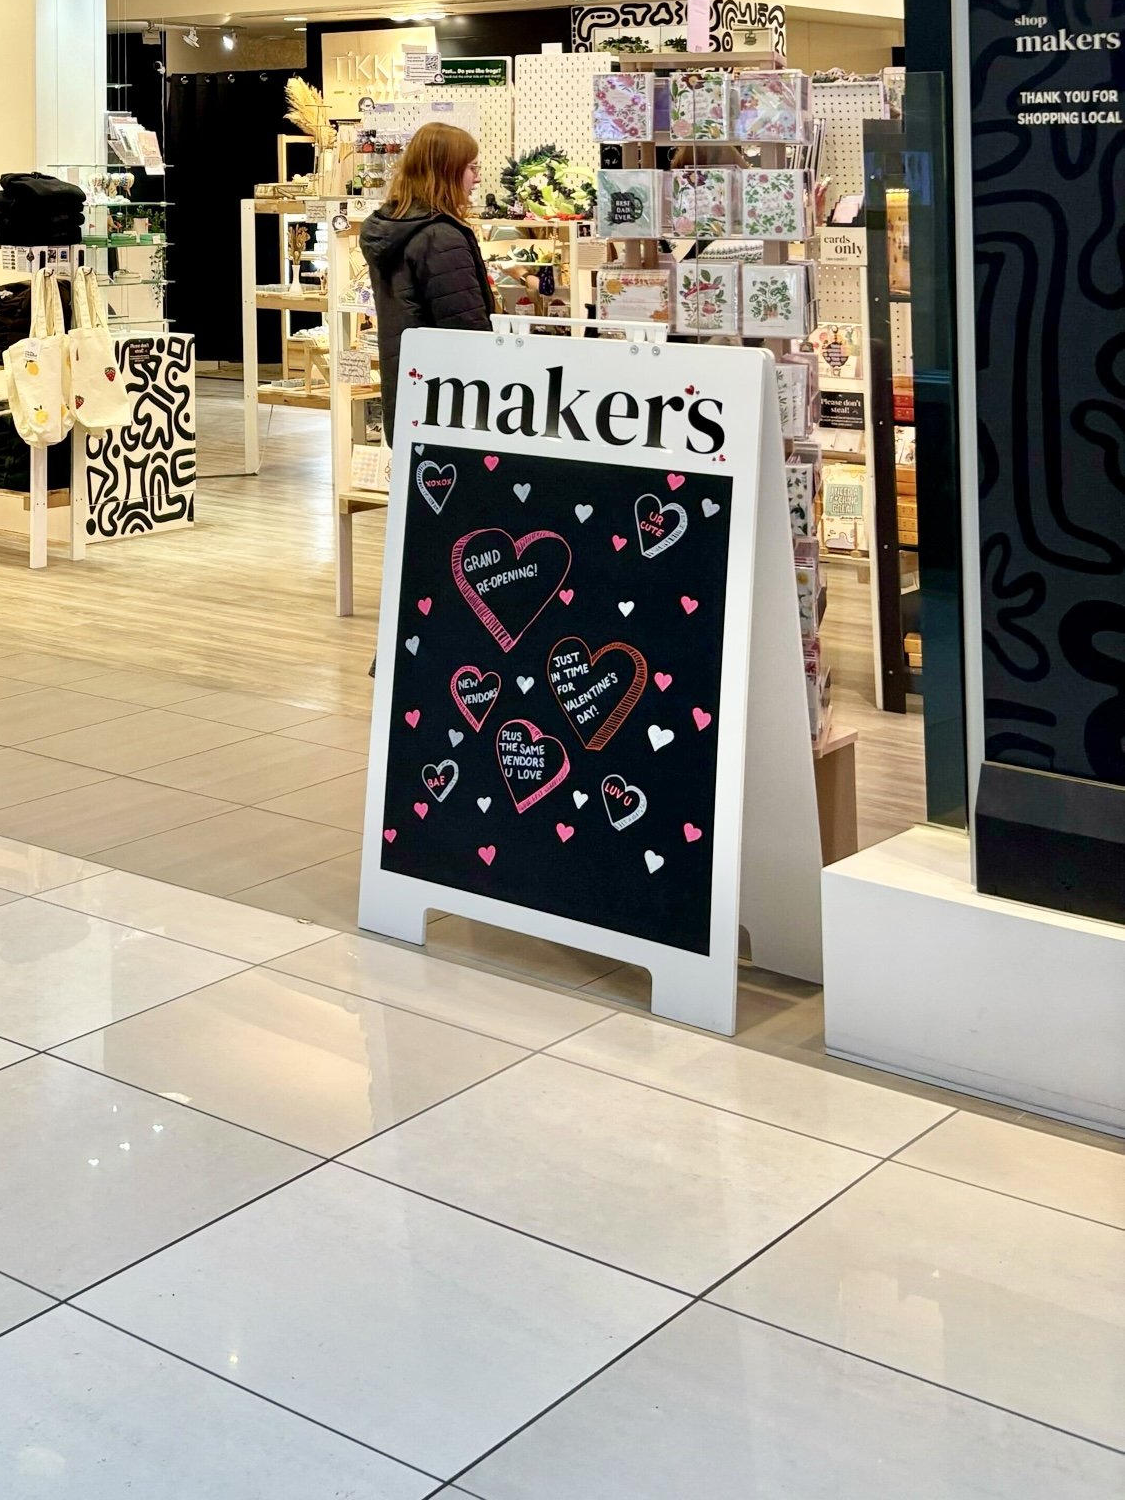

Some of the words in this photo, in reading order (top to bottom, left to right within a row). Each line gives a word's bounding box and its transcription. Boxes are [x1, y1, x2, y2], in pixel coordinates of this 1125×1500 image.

[1014, 15, 1047, 28] shop
[1015, 29, 1121, 53] makers
[1020, 91, 1061, 104] THANK
[1064, 91, 1089, 103] YOU
[1092, 90, 1119, 102] FOR
[1017, 112, 1079, 125] SHOPPING
[1081, 111, 1122, 124] LOCAL
[824, 235, 851, 243] cards
[835, 242, 864, 258] only
[421, 365, 725, 455] makers
[820, 398, 843, 406] Please
[843, 399, 861, 407] don't
[425, 477, 452, 487] XOXOX
[648, 511, 664, 526] UR
[640, 520, 665, 538] CUTE
[463, 549, 501, 573] GRAND
[476, 563, 538, 596] RE-OPENING!
[553, 651, 581, 668] JUST
[551, 670, 562, 683] IN
[563, 663, 590, 680] TIME
[458, 678, 478, 690] NEW
[556, 682, 576, 695] FOR
[461, 687, 498, 705] VENDORS
[564, 672, 619, 713] VALENTINE'S
[576, 704, 600, 726] DAY!
[502, 730, 522, 742] PLUS
[499, 742, 518, 754] THE
[519, 743, 545, 756] SAME
[502, 755, 545, 768] VENDORS
[427, 774, 446, 789] BAE
[505, 768, 513, 779] U
[518, 768, 542, 780] LOVE
[604, 781, 624, 800] LUV
[623, 794, 633, 807] U
